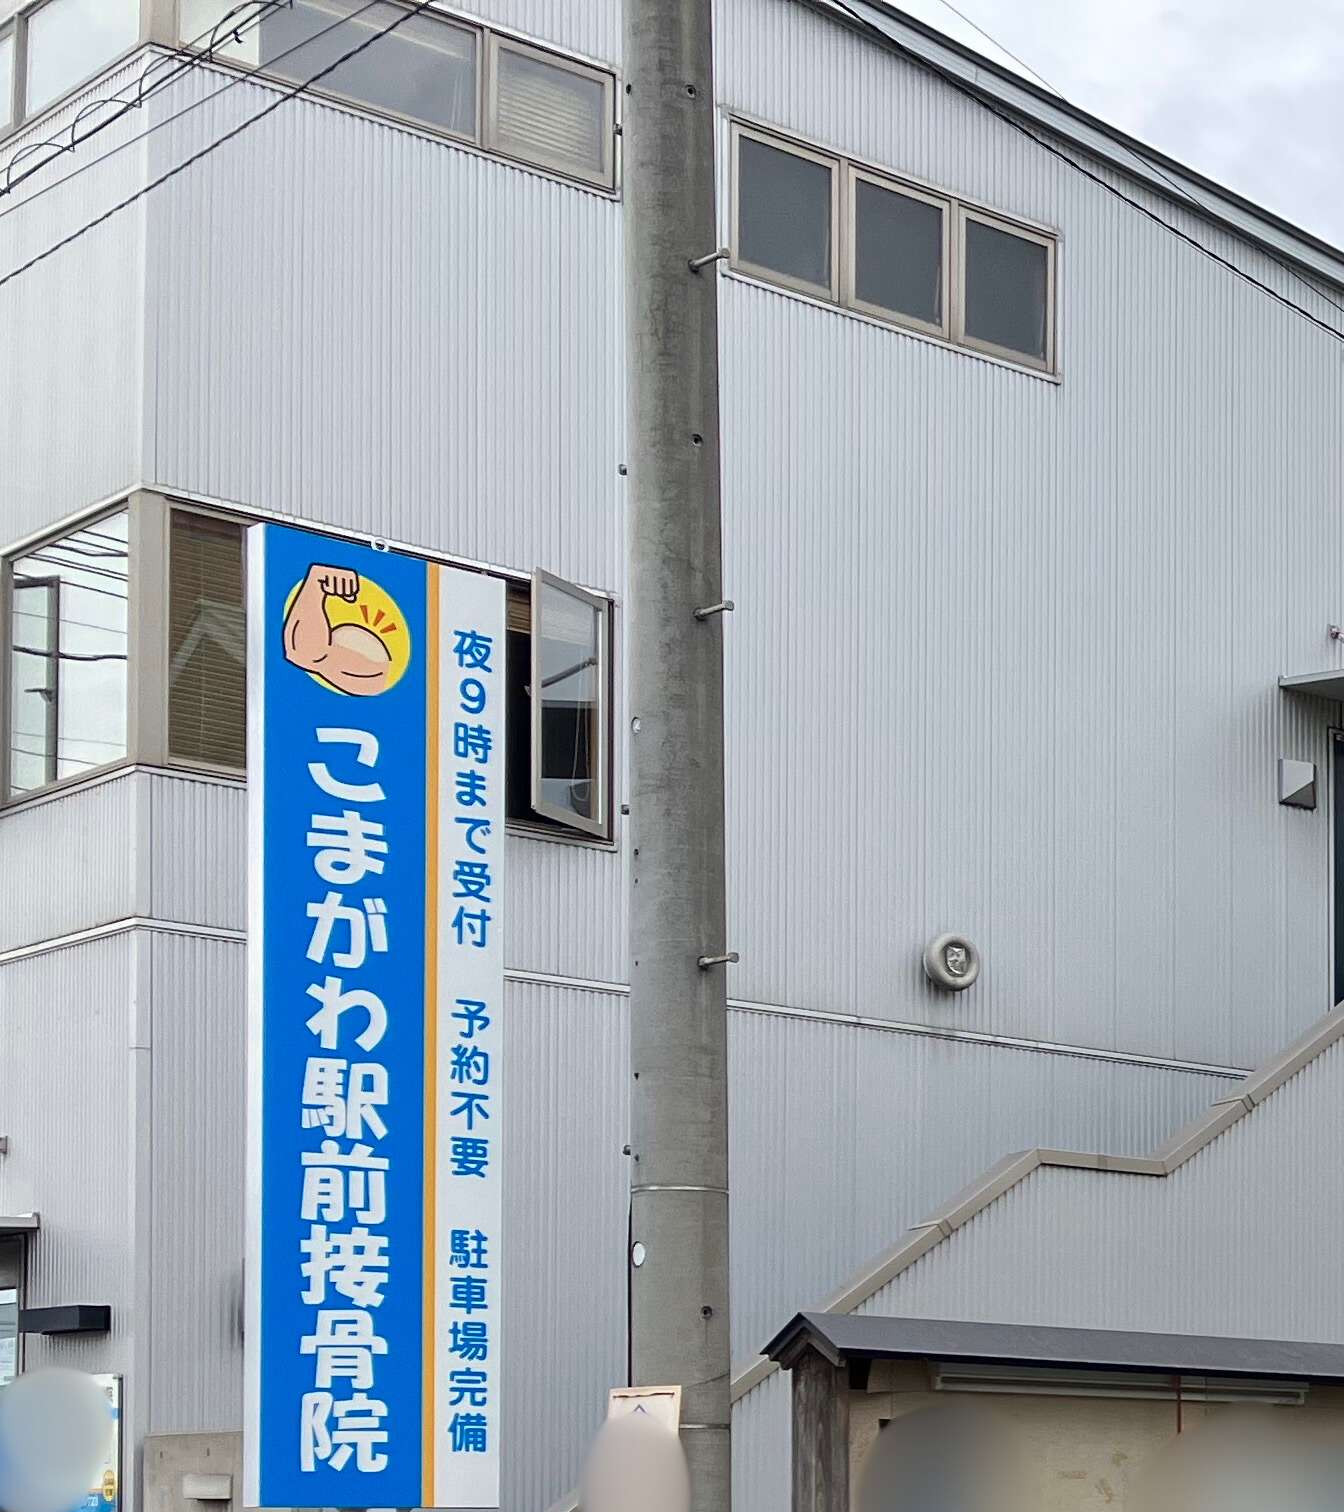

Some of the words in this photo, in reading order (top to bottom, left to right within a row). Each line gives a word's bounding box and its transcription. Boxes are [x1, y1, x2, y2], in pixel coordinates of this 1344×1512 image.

[451, 629, 493, 948] 夜9時まで受付
[300, 727, 389, 1473] こまがわ駅前接骨院
[450, 998, 490, 1179] 予約不要
[448, 1229, 489, 1454] 駐車場完備
